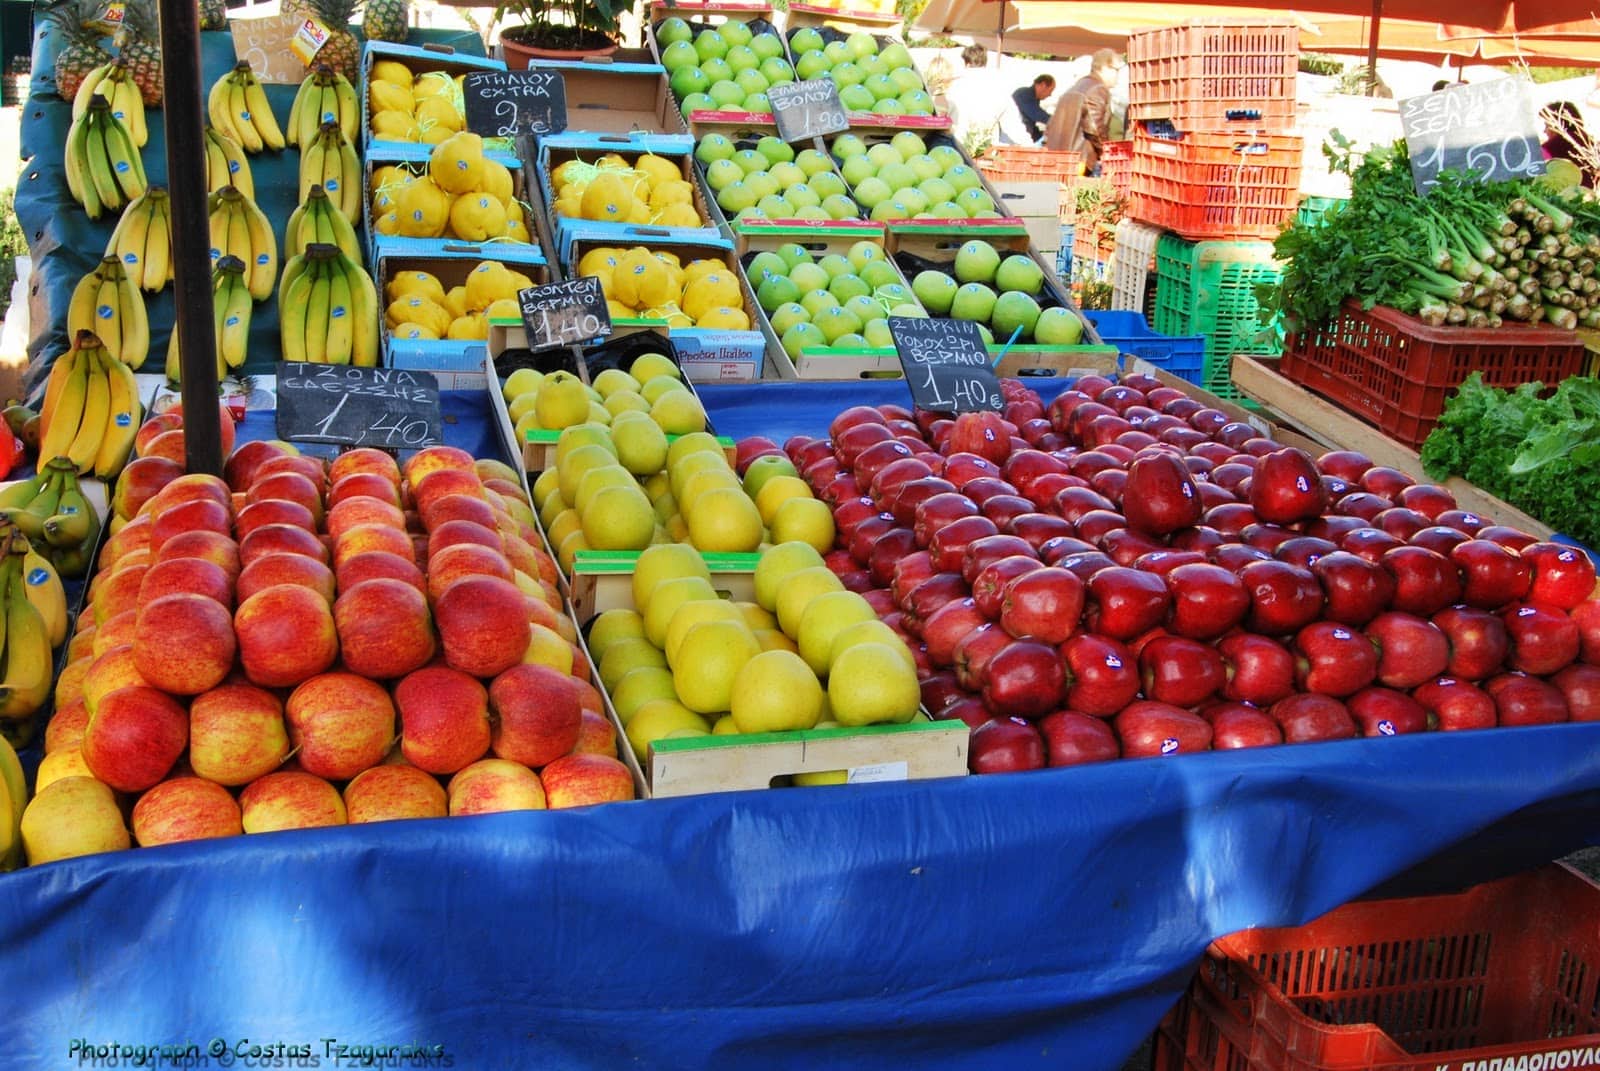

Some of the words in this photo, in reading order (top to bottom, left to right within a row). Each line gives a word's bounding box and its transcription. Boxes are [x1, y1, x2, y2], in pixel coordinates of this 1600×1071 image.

[480, 85, 550, 98] EXTRA
[523, 294, 595, 314] ΒΕΡΜΙΟ
[910, 348, 985, 366] ΒΕΡΜΙΟ
[287, 362, 418, 386] ΤΖΟΝΑ
[284, 377, 433, 404] ΕΔΕΣΣΗΣ
